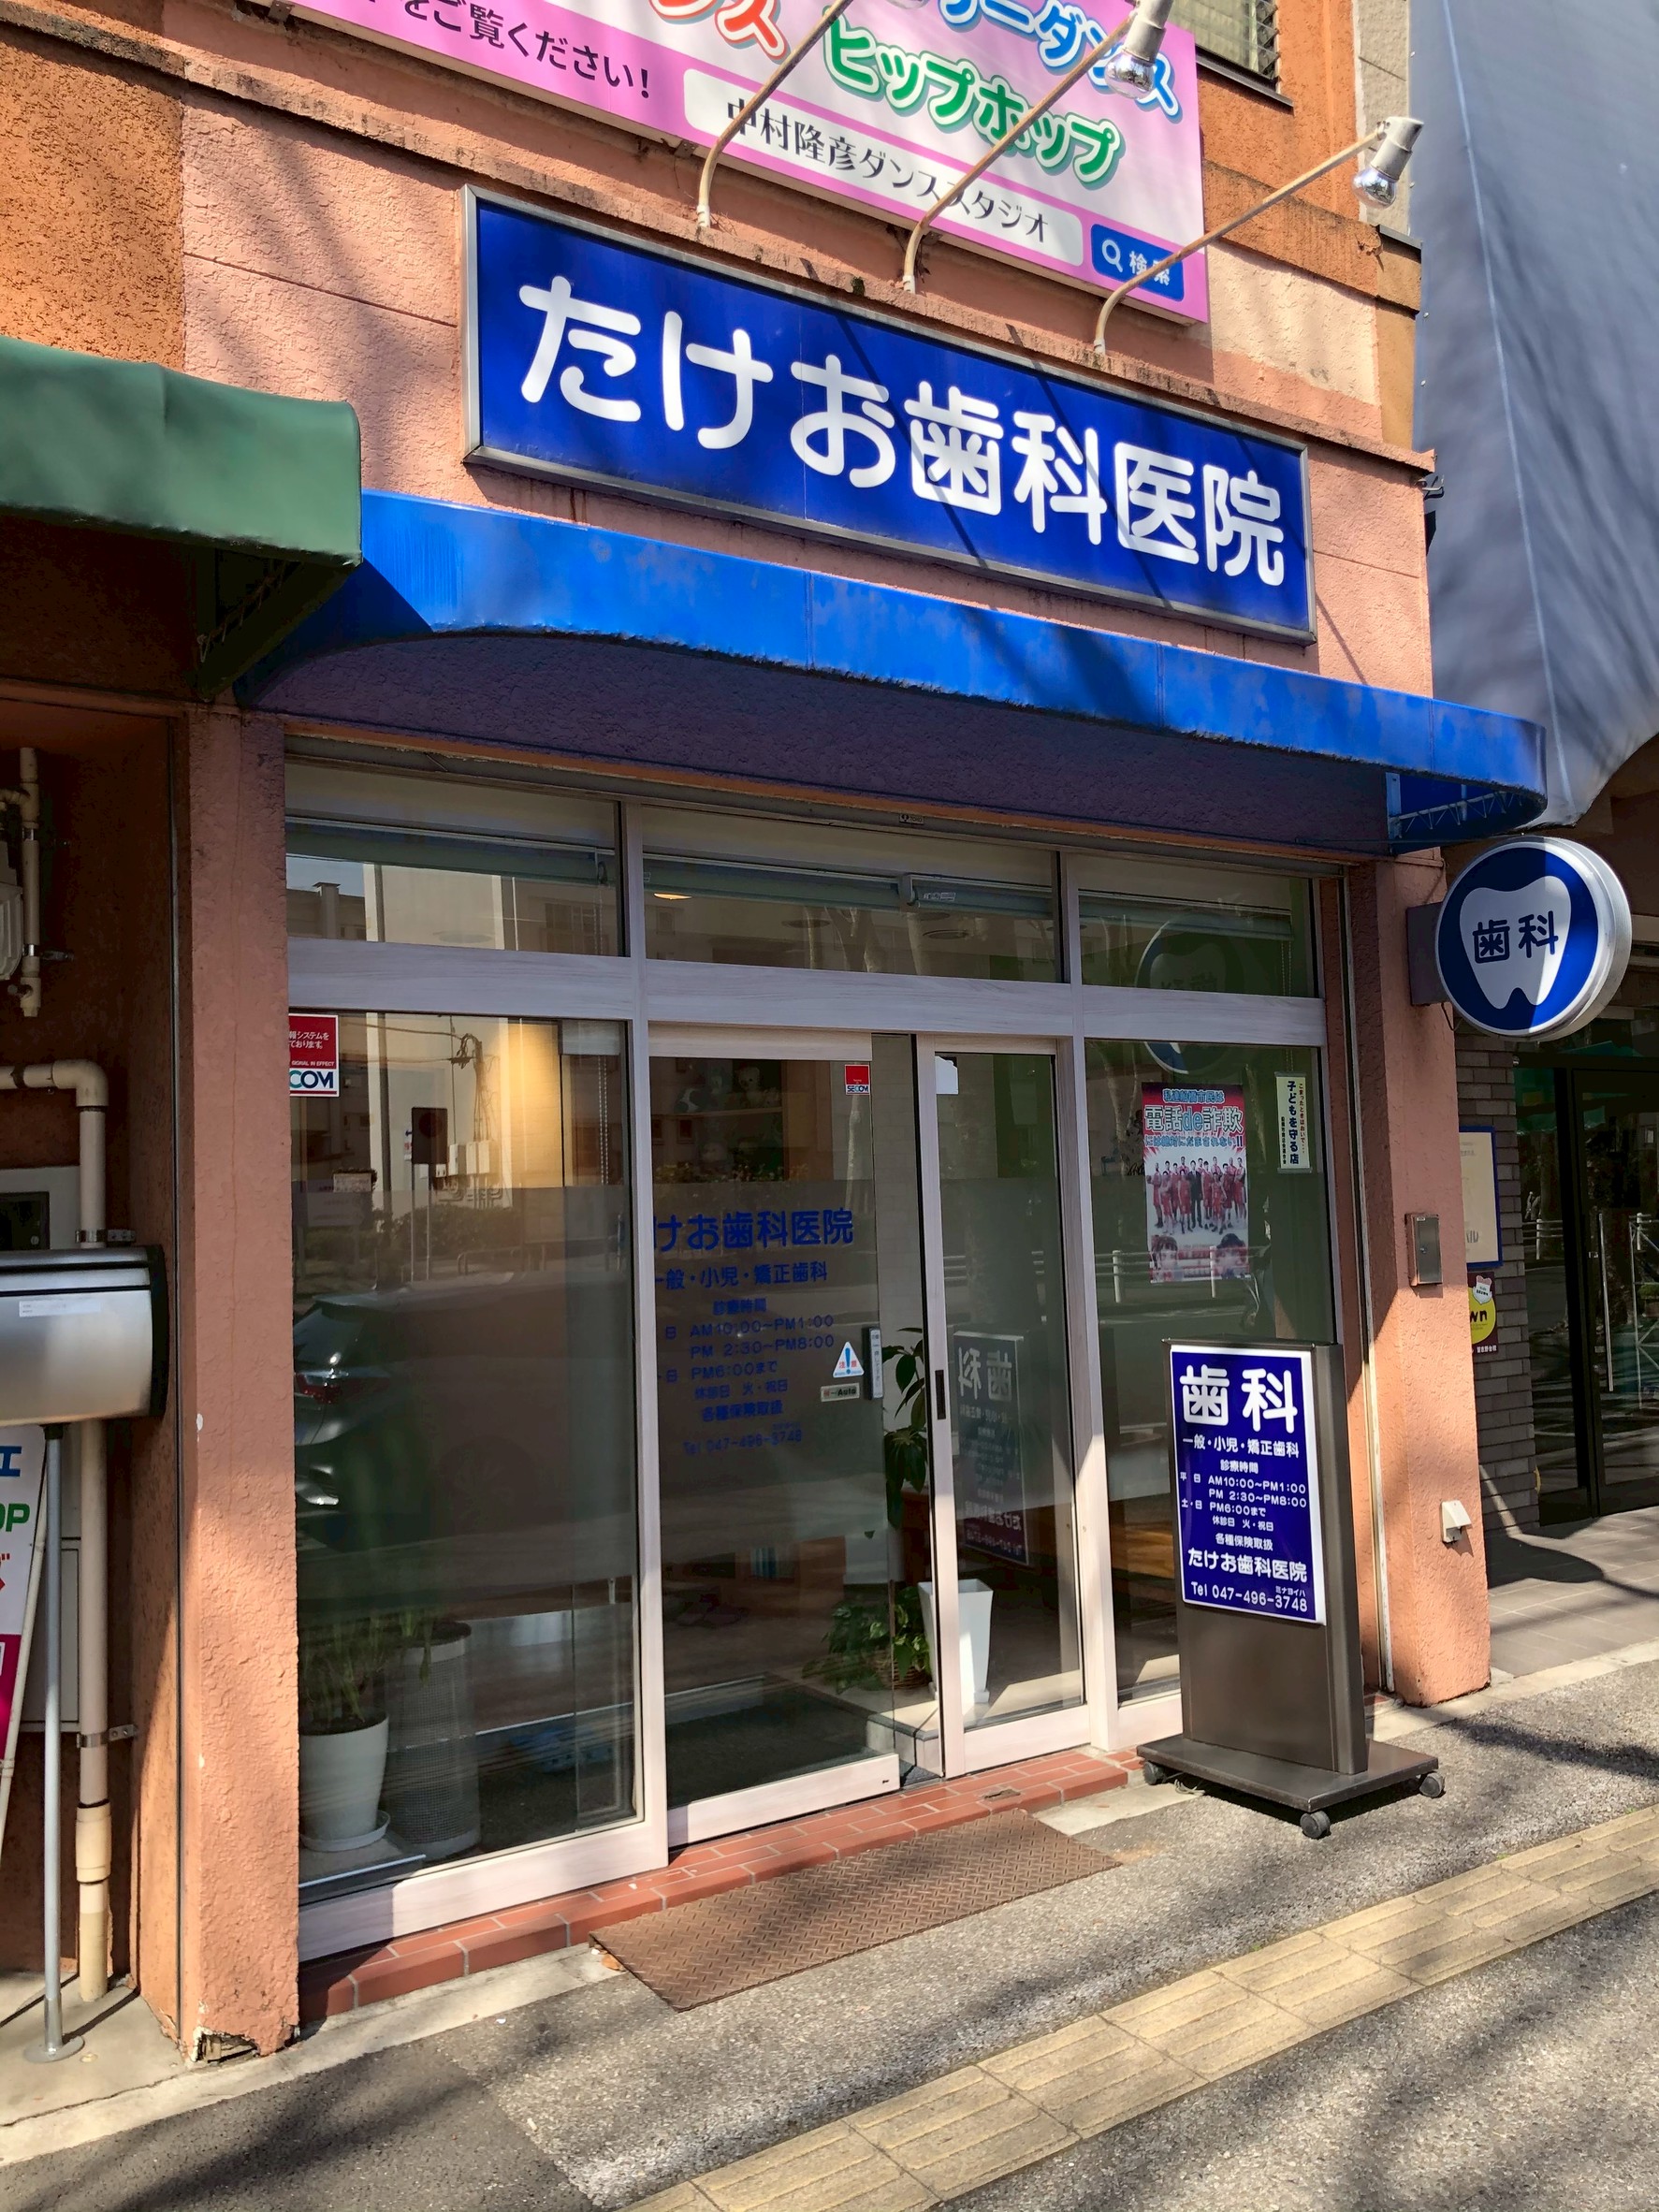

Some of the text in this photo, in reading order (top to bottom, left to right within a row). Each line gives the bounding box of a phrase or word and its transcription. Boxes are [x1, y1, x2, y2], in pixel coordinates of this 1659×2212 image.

[823, 7, 1121, 182] ヒップホップ
[727, 97, 1049, 243] 中村隆彦ダンススタジオ
[518, 275, 1286, 587] たけお歯科医院
[1472, 910, 1559, 964] 歯科
[1144, 1105, 1243, 1132] 電話de詐欺
[1288, 1080, 1299, 1165] 子どもを守る店
[1179, 1363, 1299, 1433] 歯科
[1182, 1434, 1300, 1458] 一般・小児・矯正歯科
[1220, 1459, 1259, 1474] 診療時間
[1209, 1488, 1224, 1500] PM
[1210, 1502, 1266, 1517] PM6:00まで
[0, 1503, 30, 1532] P
[1215, 1533, 1273, 1550] 各種保険取扱
[1188, 1547, 1307, 1583] たけお歯科医院
[1191, 1581, 1308, 1612] Tel 047-496-3748
